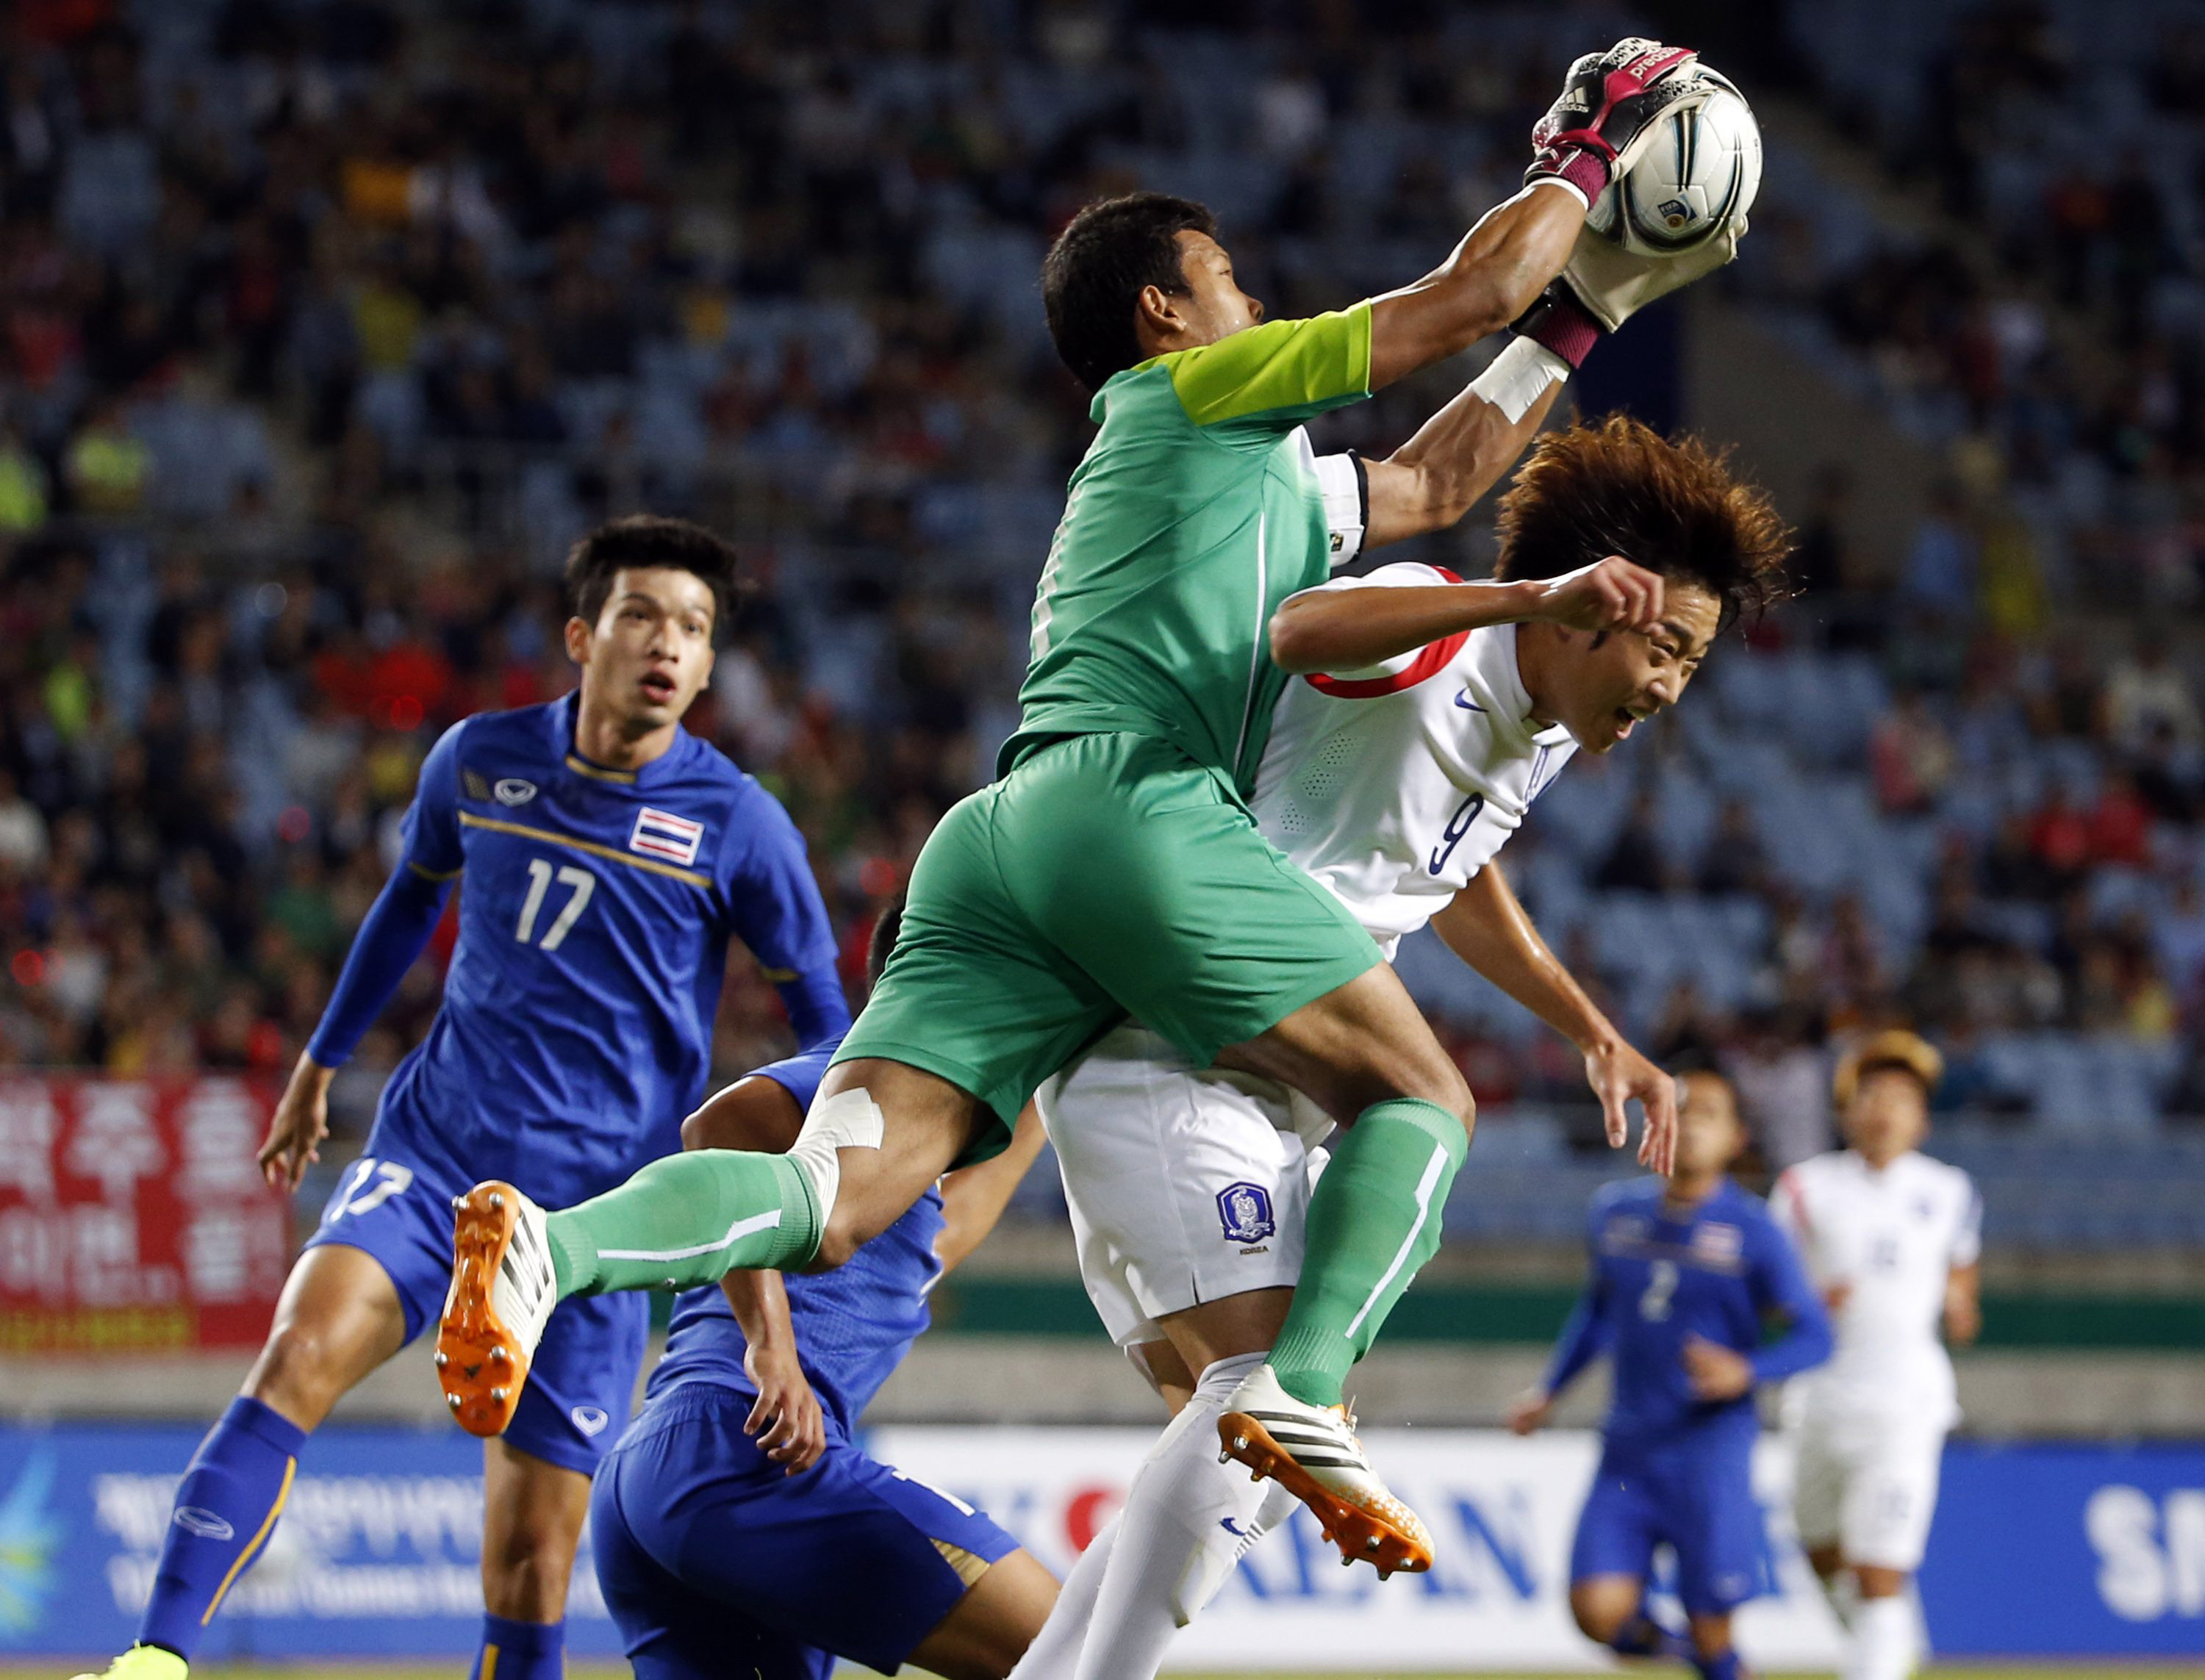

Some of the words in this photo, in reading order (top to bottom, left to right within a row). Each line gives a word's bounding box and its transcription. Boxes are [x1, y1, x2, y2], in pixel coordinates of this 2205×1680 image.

[1429, 791, 1484, 875] 9
[515, 858, 596, 951] 17
[329, 1157, 414, 1223] 17
[1239, 1245, 1269, 1255] KOREA
